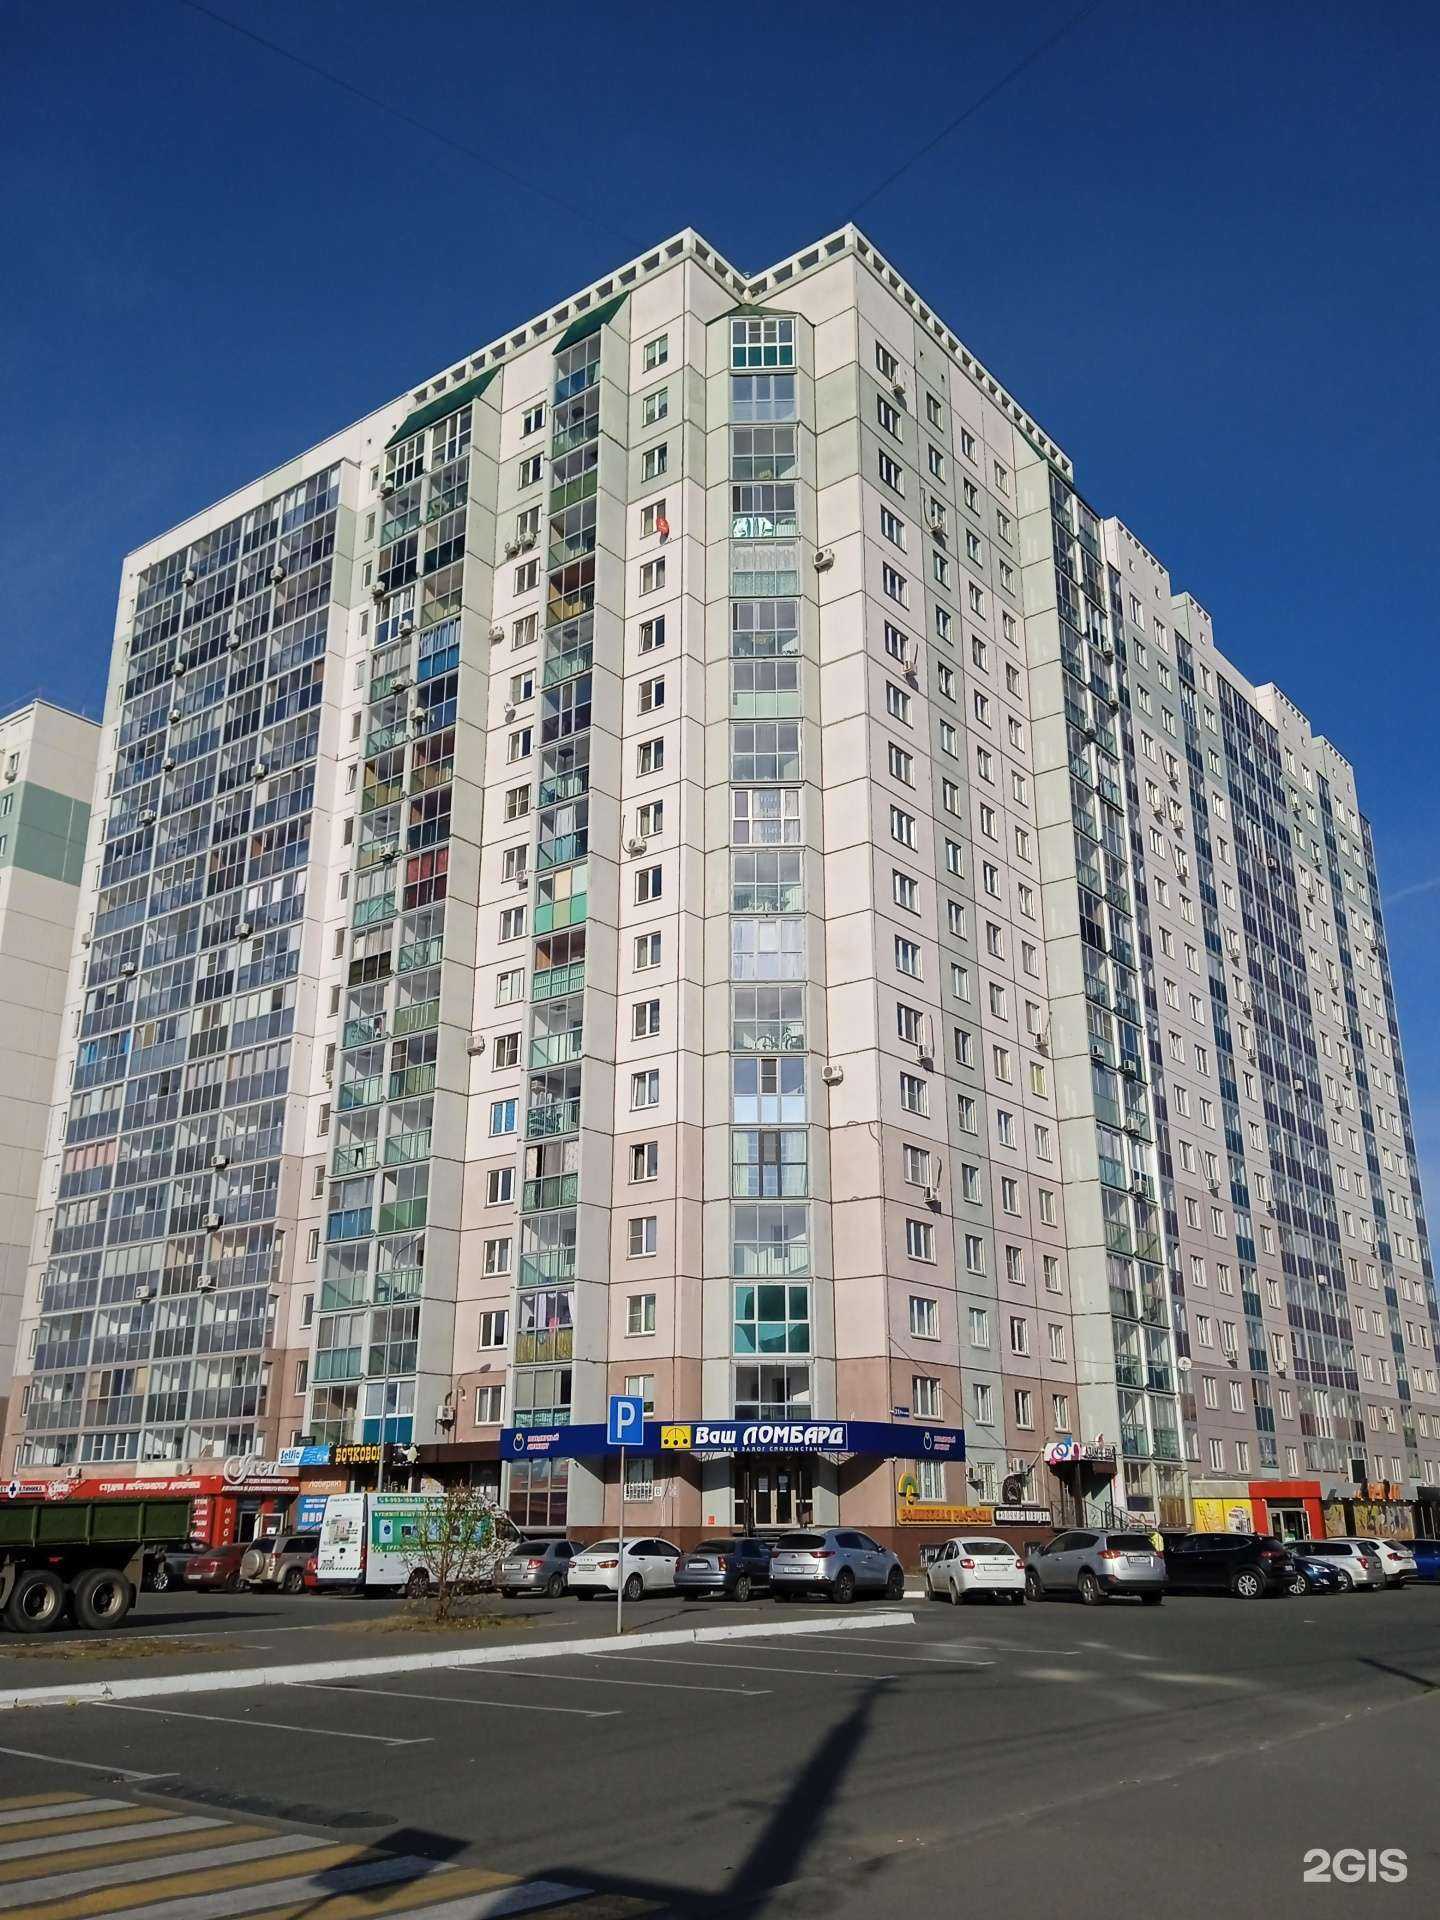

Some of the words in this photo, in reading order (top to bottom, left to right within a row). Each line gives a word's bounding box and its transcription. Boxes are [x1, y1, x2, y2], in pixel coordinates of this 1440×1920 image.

[617, 1401, 636, 1439] P
[695, 1426, 736, 1444] Ваш
[743, 1425, 844, 1446] ЛОМБАРД
